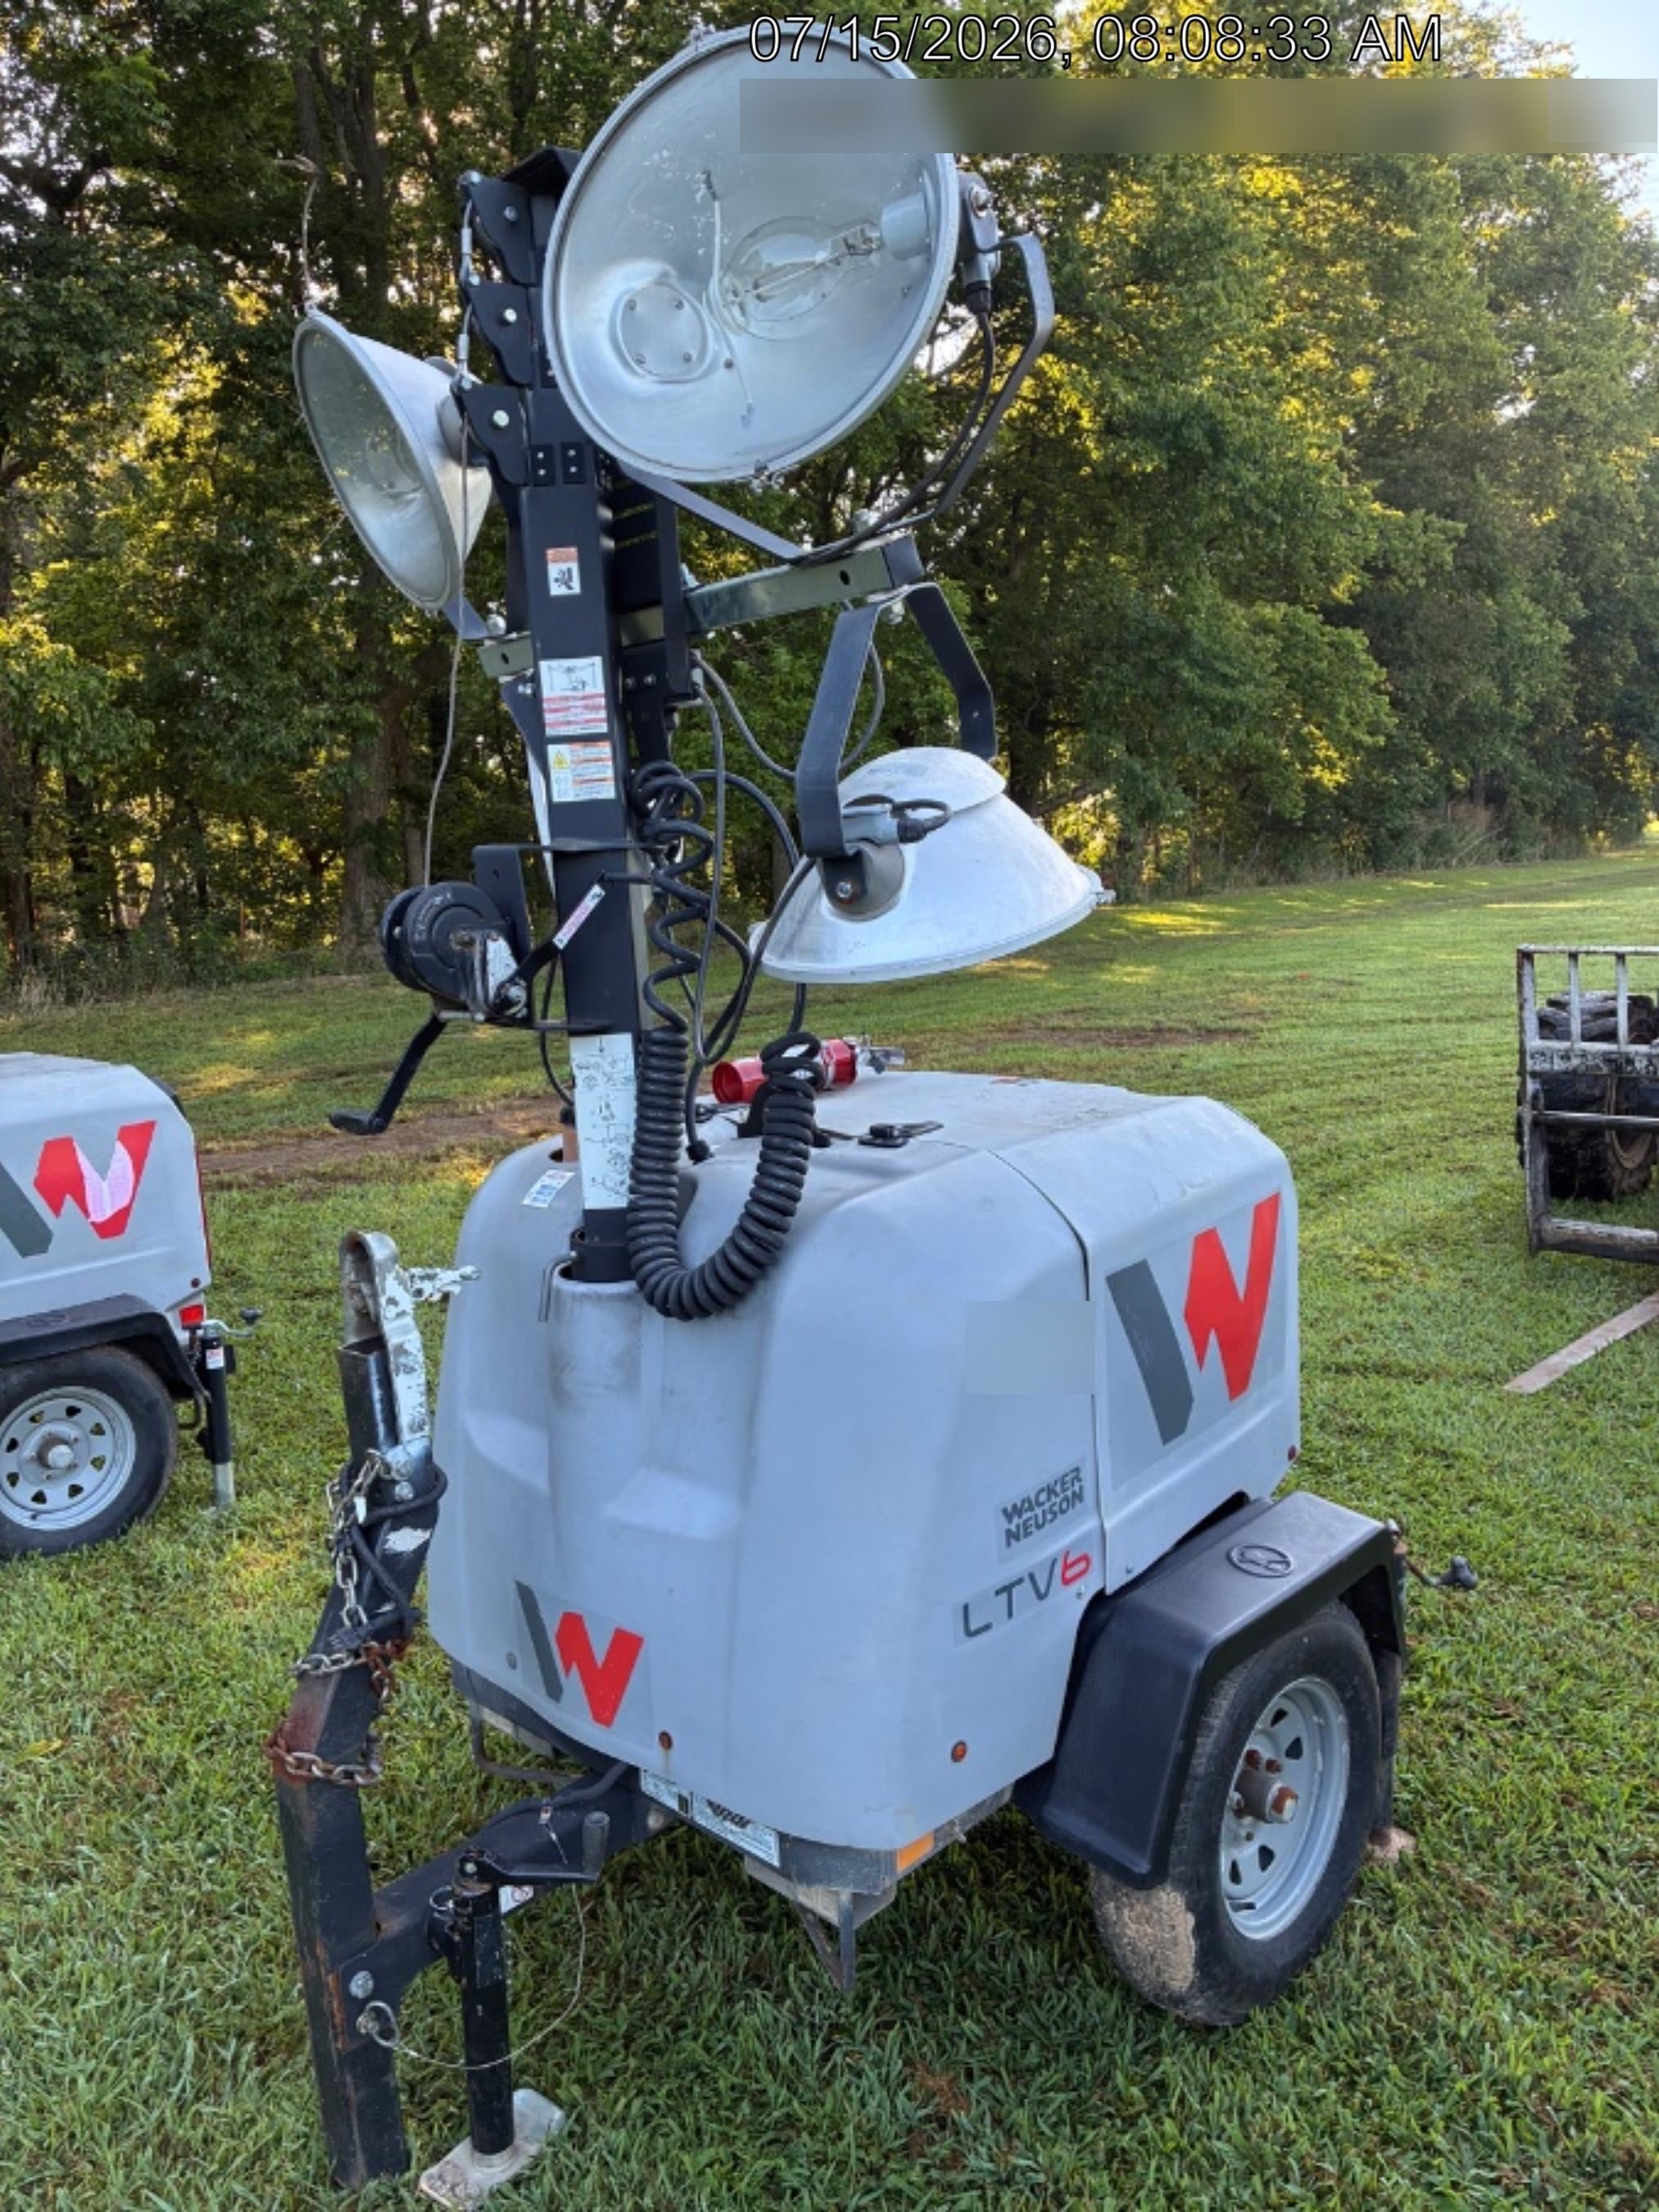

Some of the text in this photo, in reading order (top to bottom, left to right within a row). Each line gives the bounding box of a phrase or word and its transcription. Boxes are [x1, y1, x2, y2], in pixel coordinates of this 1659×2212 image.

[1002, 1466, 1082, 1525] WACKER
[1005, 1484, 1084, 1548] NEUSON
[963, 1550, 1091, 1637] LTV6
